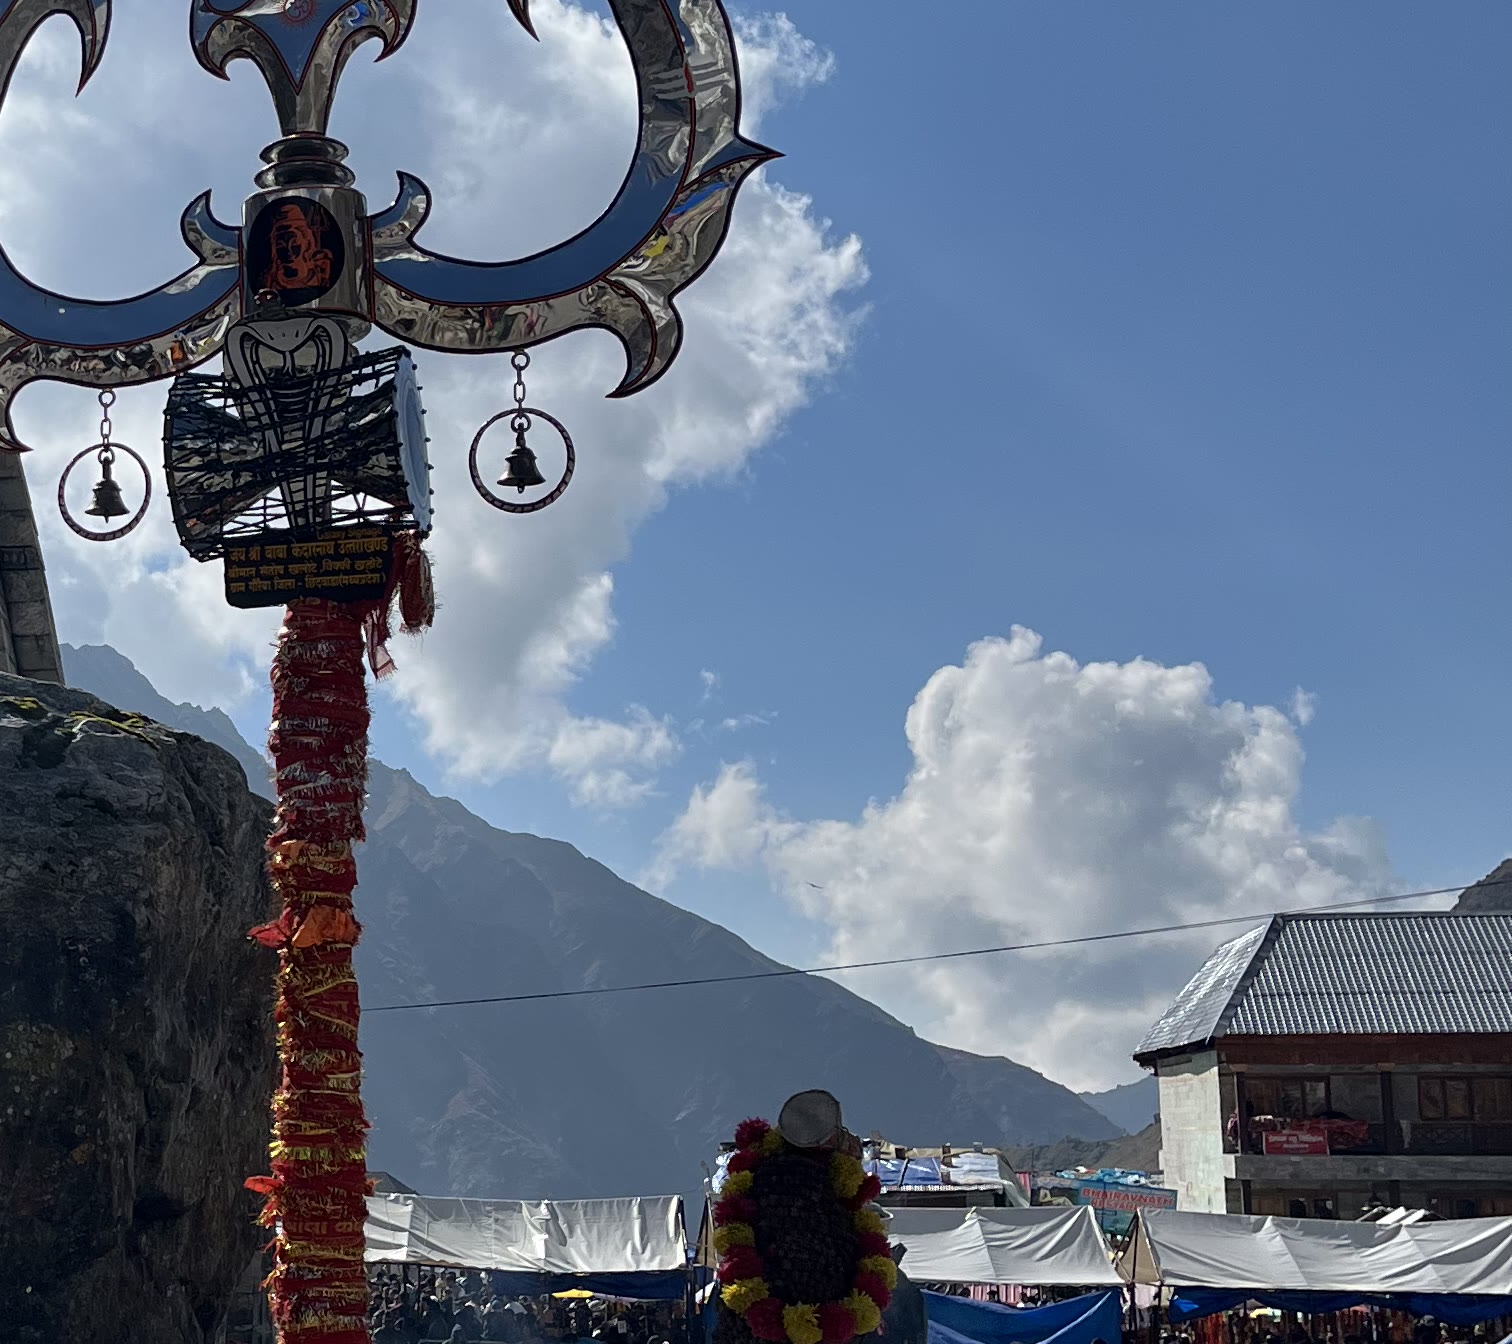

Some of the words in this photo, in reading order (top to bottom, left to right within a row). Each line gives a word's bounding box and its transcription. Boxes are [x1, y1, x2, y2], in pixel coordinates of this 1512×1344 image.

[228, 547, 246, 562] जय
[248, 544, 261, 561] श्री
[263, 544, 288, 559] बाबा
